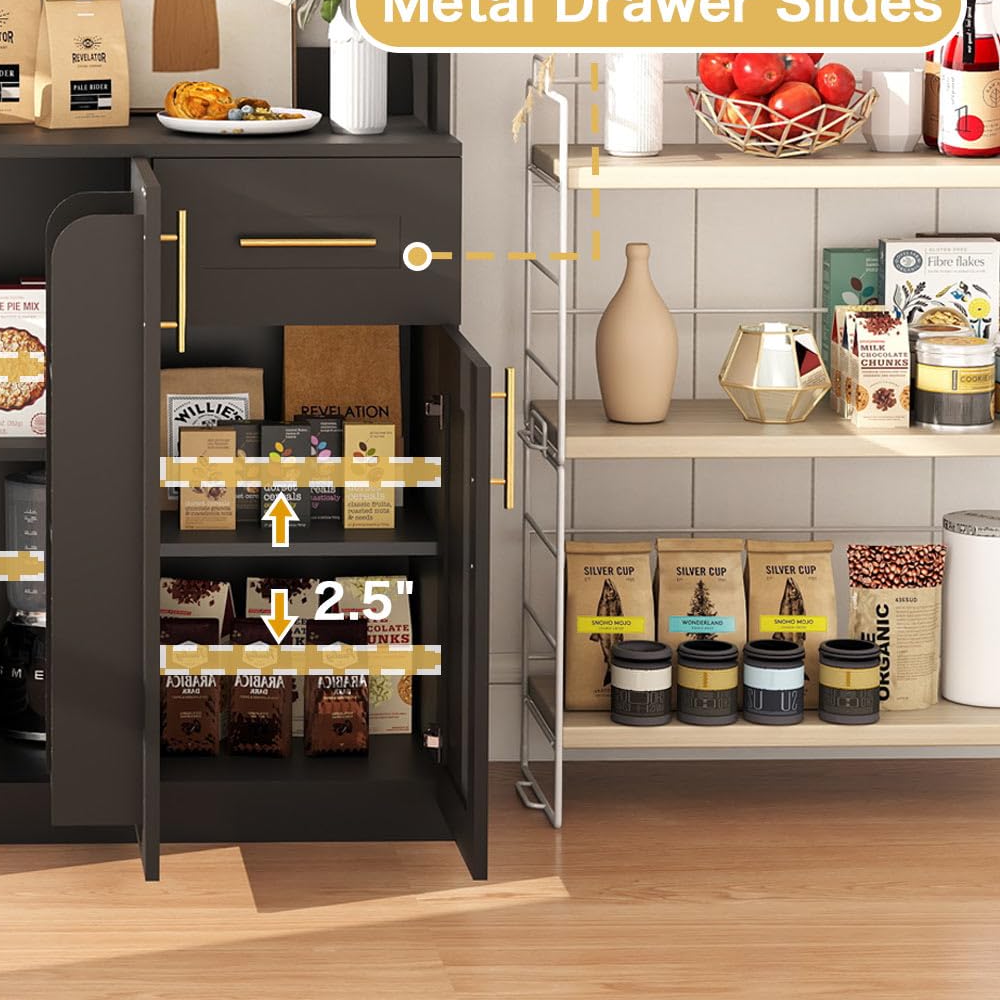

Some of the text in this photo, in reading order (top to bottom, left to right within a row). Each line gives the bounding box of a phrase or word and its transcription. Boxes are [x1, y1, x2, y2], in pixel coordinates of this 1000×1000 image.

[72, 53, 107, 63] REVELATOR
[927, 255, 985, 267] Fibre flakes
[7, 302, 21, 311] PIE
[23, 302, 40, 311] MIX
[301, 405, 389, 418] REVELATION
[584, 566, 635, 576] SILVER CUP
[676, 566, 727, 577] SILVER CUP
[766, 565, 817, 575] SILVER CUP
[876, 604, 890, 701] ORGANIC
